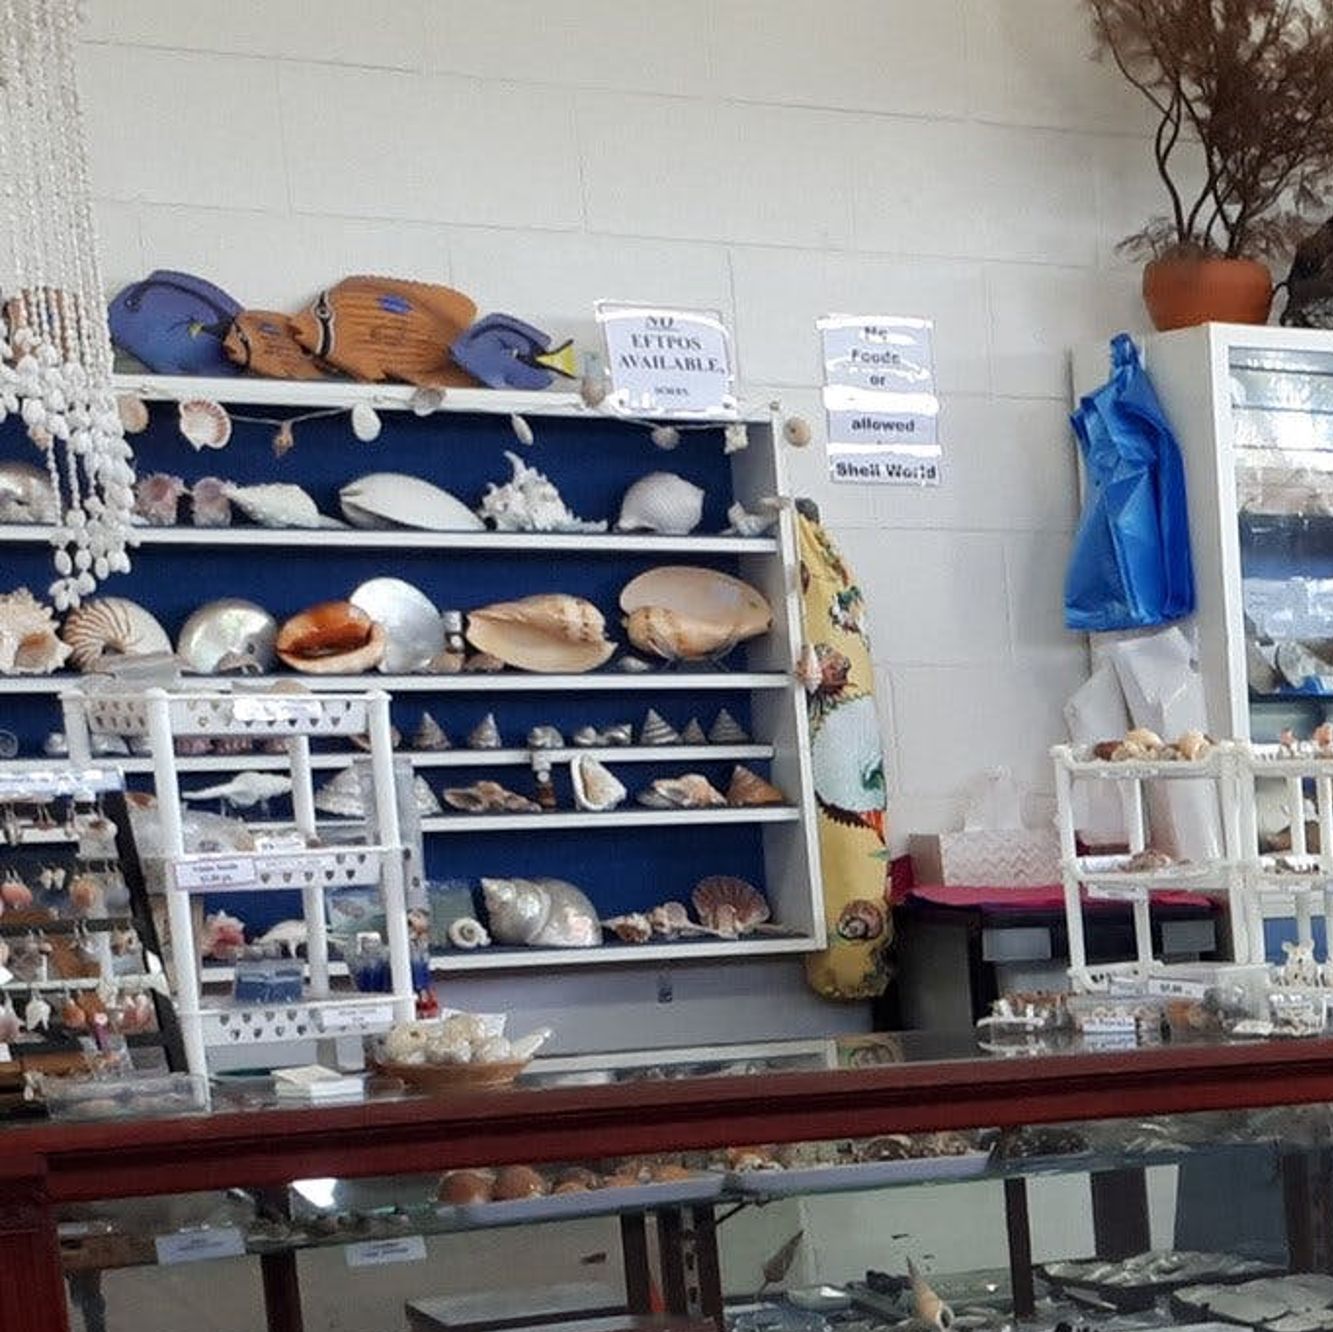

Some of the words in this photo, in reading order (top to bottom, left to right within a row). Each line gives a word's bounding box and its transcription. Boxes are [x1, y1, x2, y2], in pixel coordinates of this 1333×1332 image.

[631, 333, 702, 350] EFTPOS
[851, 418, 915, 432] allowed
[836, 462, 880, 477] Shell
[886, 464, 937, 480] World
